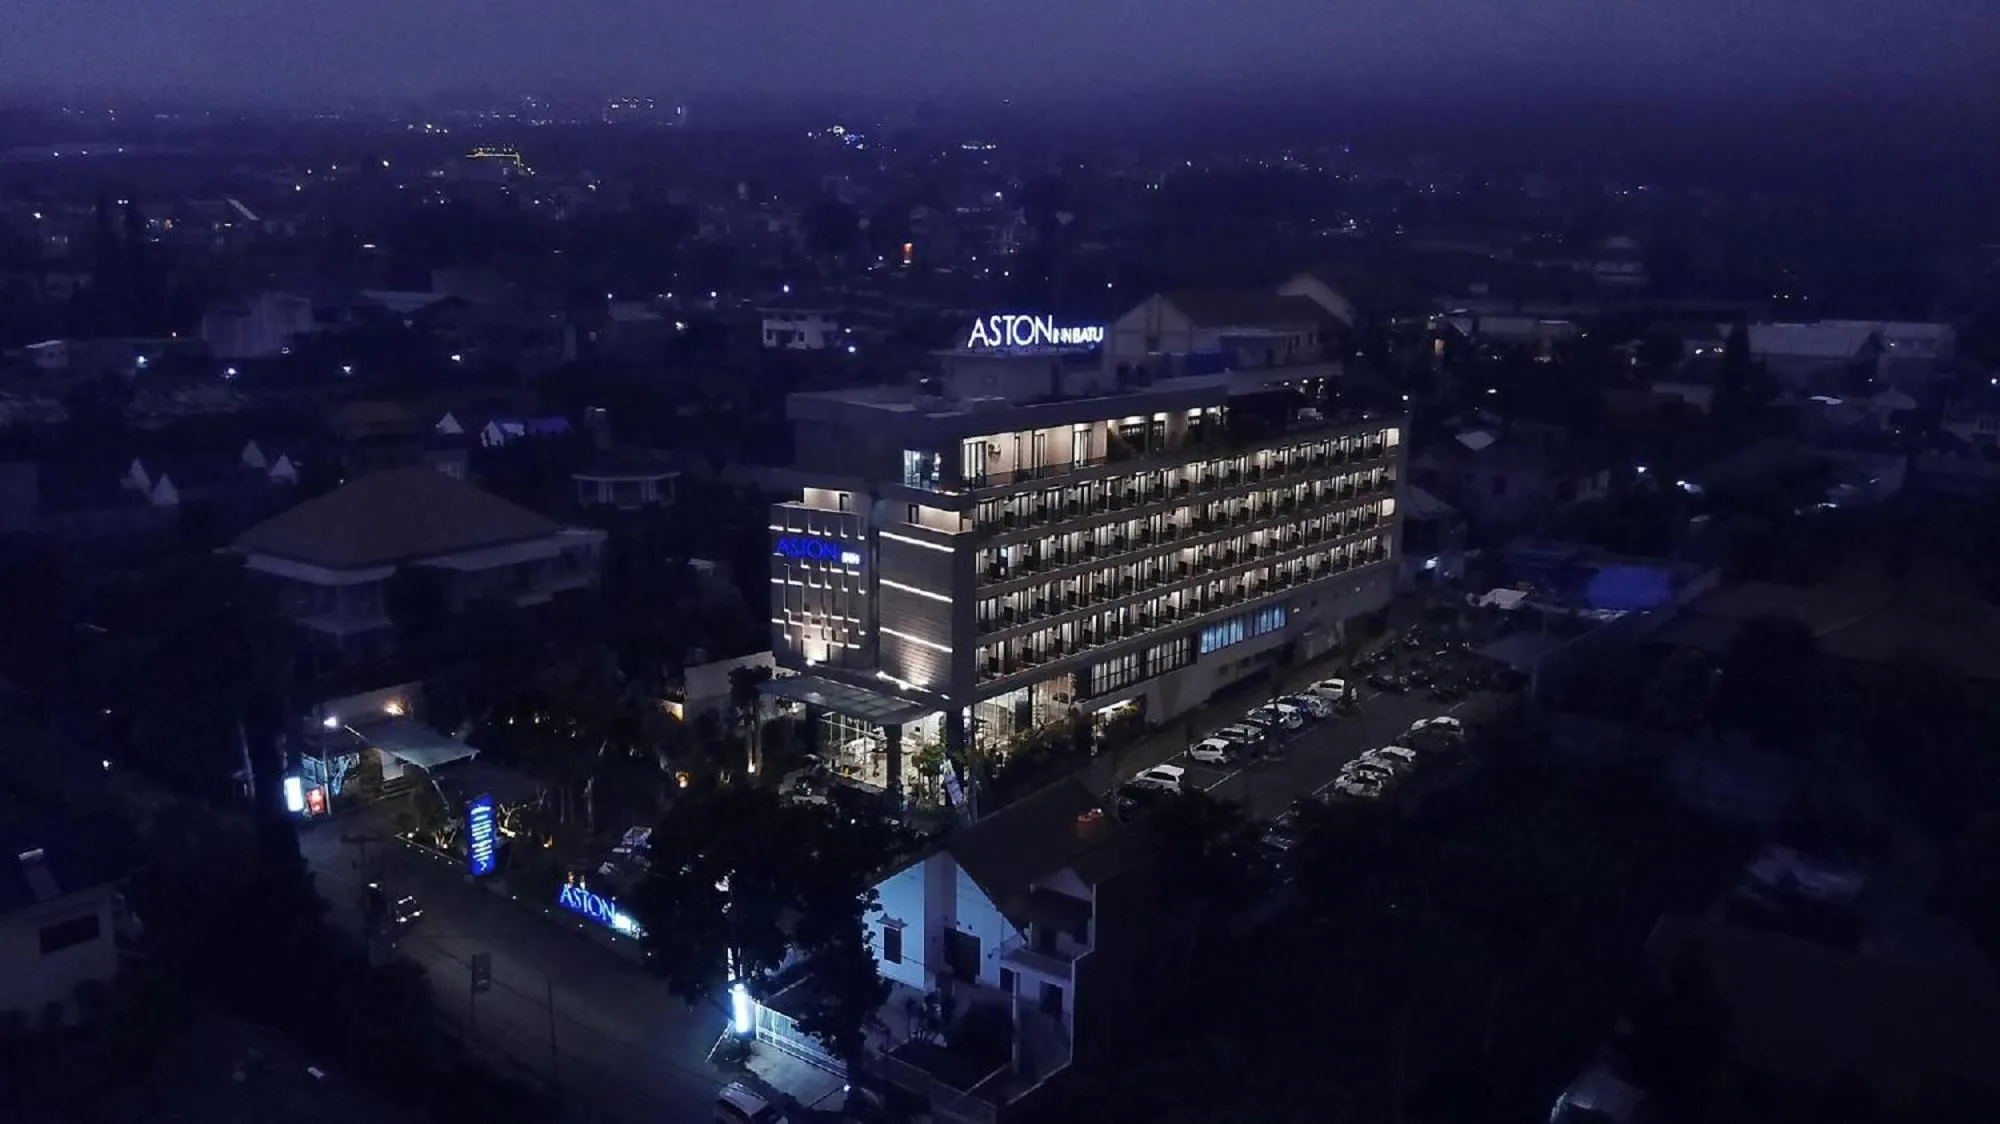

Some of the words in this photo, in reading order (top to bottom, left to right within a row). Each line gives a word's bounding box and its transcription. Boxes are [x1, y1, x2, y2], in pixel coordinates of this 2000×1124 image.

[967, 315, 1053, 348] ASTON
[1072, 327, 1104, 344] BATU
[775, 538, 838, 561] ASTON
[560, 884, 616, 925] ASTON
